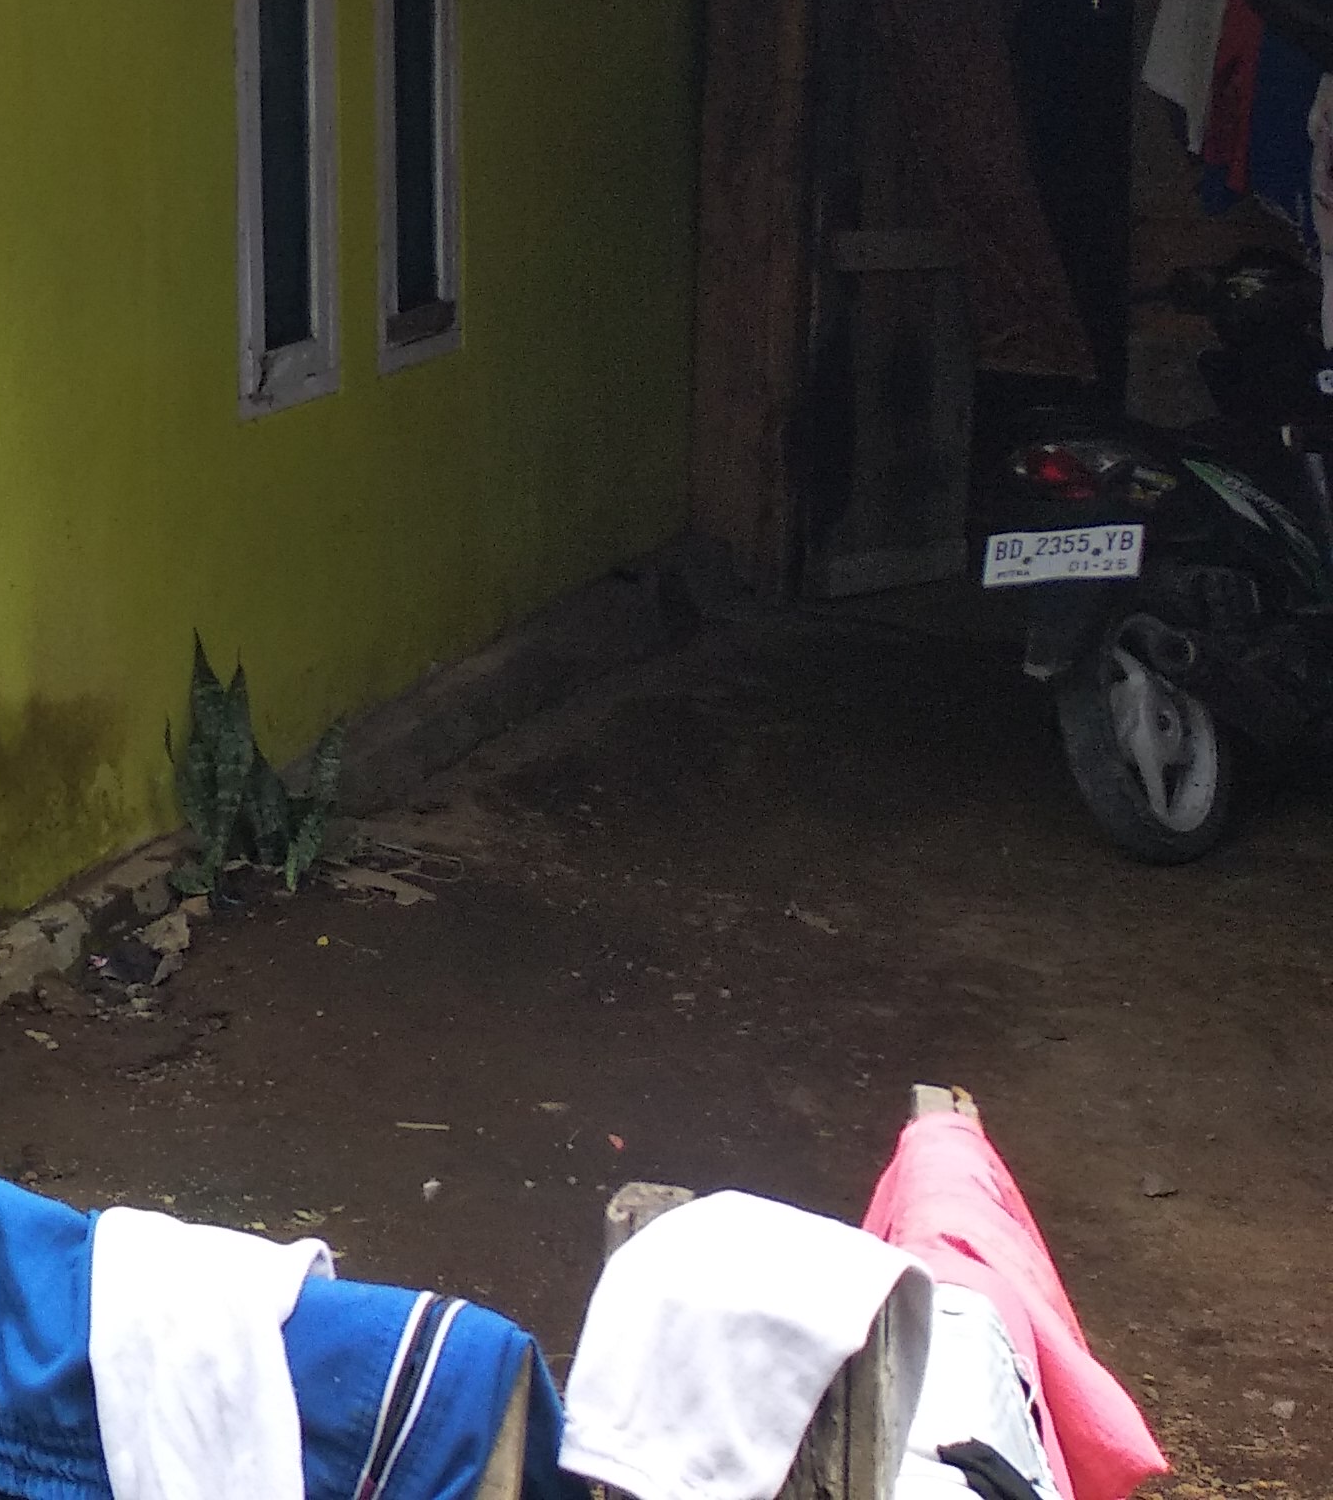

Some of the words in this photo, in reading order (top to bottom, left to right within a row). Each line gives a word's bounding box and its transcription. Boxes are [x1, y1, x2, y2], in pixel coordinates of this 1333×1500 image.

[995, 539, 1023, 561] BD
[1035, 533, 1091, 556] 2355
[1105, 531, 1134, 550] YB
